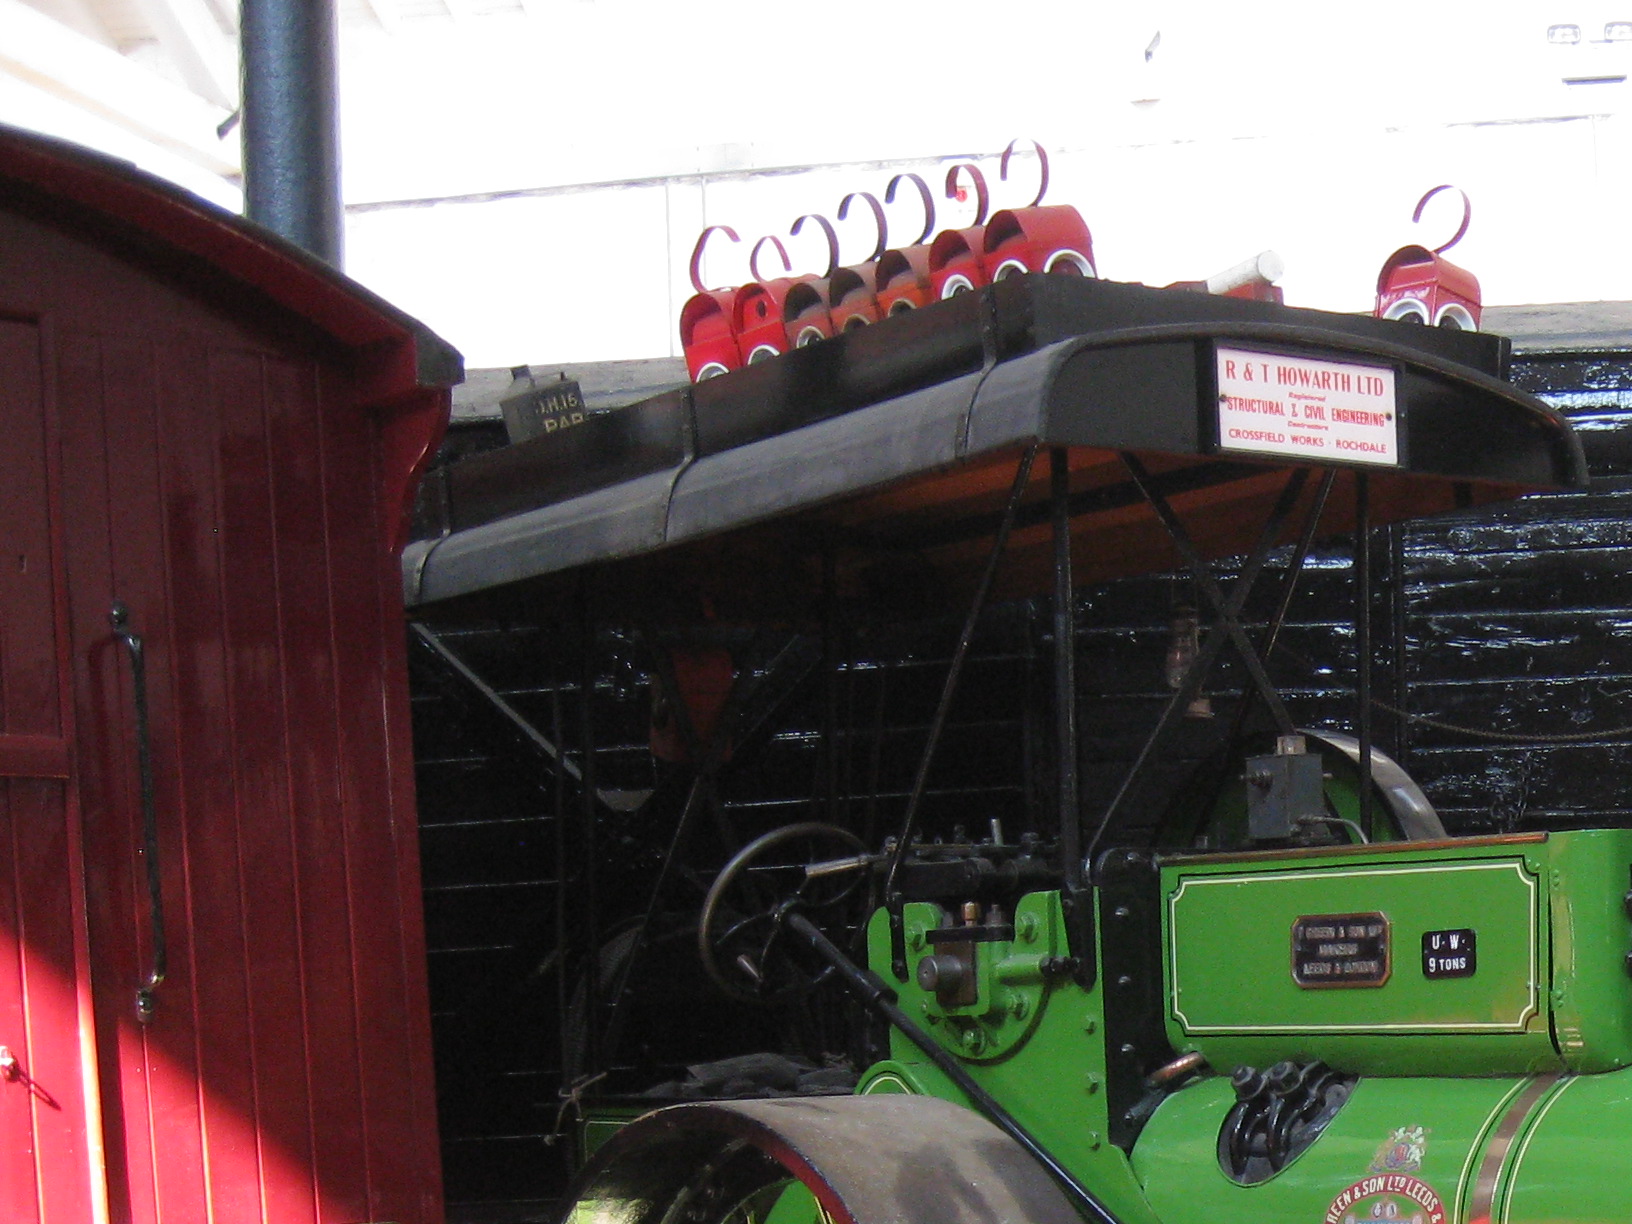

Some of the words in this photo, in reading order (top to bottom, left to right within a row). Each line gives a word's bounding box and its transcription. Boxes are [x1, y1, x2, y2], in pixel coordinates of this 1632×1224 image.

[1225, 360, 1236, 380] R
[1244, 361, 1254, 382] &
[1261, 363, 1270, 383] T
[1277, 366, 1351, 393] HOWARTH
[1357, 375, 1384, 397] LTD
[1226, 396, 1286, 417] STRUCTURAL
[1304, 404, 1327, 421] CIVIL
[1331, 408, 1385, 427] ENGINEERING
[1228, 428, 1286, 443] CROSSFIELD
[1291, 434, 1325, 447] WORKS
[1336, 439, 1387, 454] ROCHDALE
[1428, 957, 1436, 973] 9
[1439, 957, 1467, 971] TONS
[1353, 1186, 1362, 1201] &
[1362, 1176, 1386, 1197] SON
[1387, 1175, 1407, 1192] LTD
[1406, 1181, 1439, 1213] LEEDS
[1431, 1212, 1442, 1224] &
